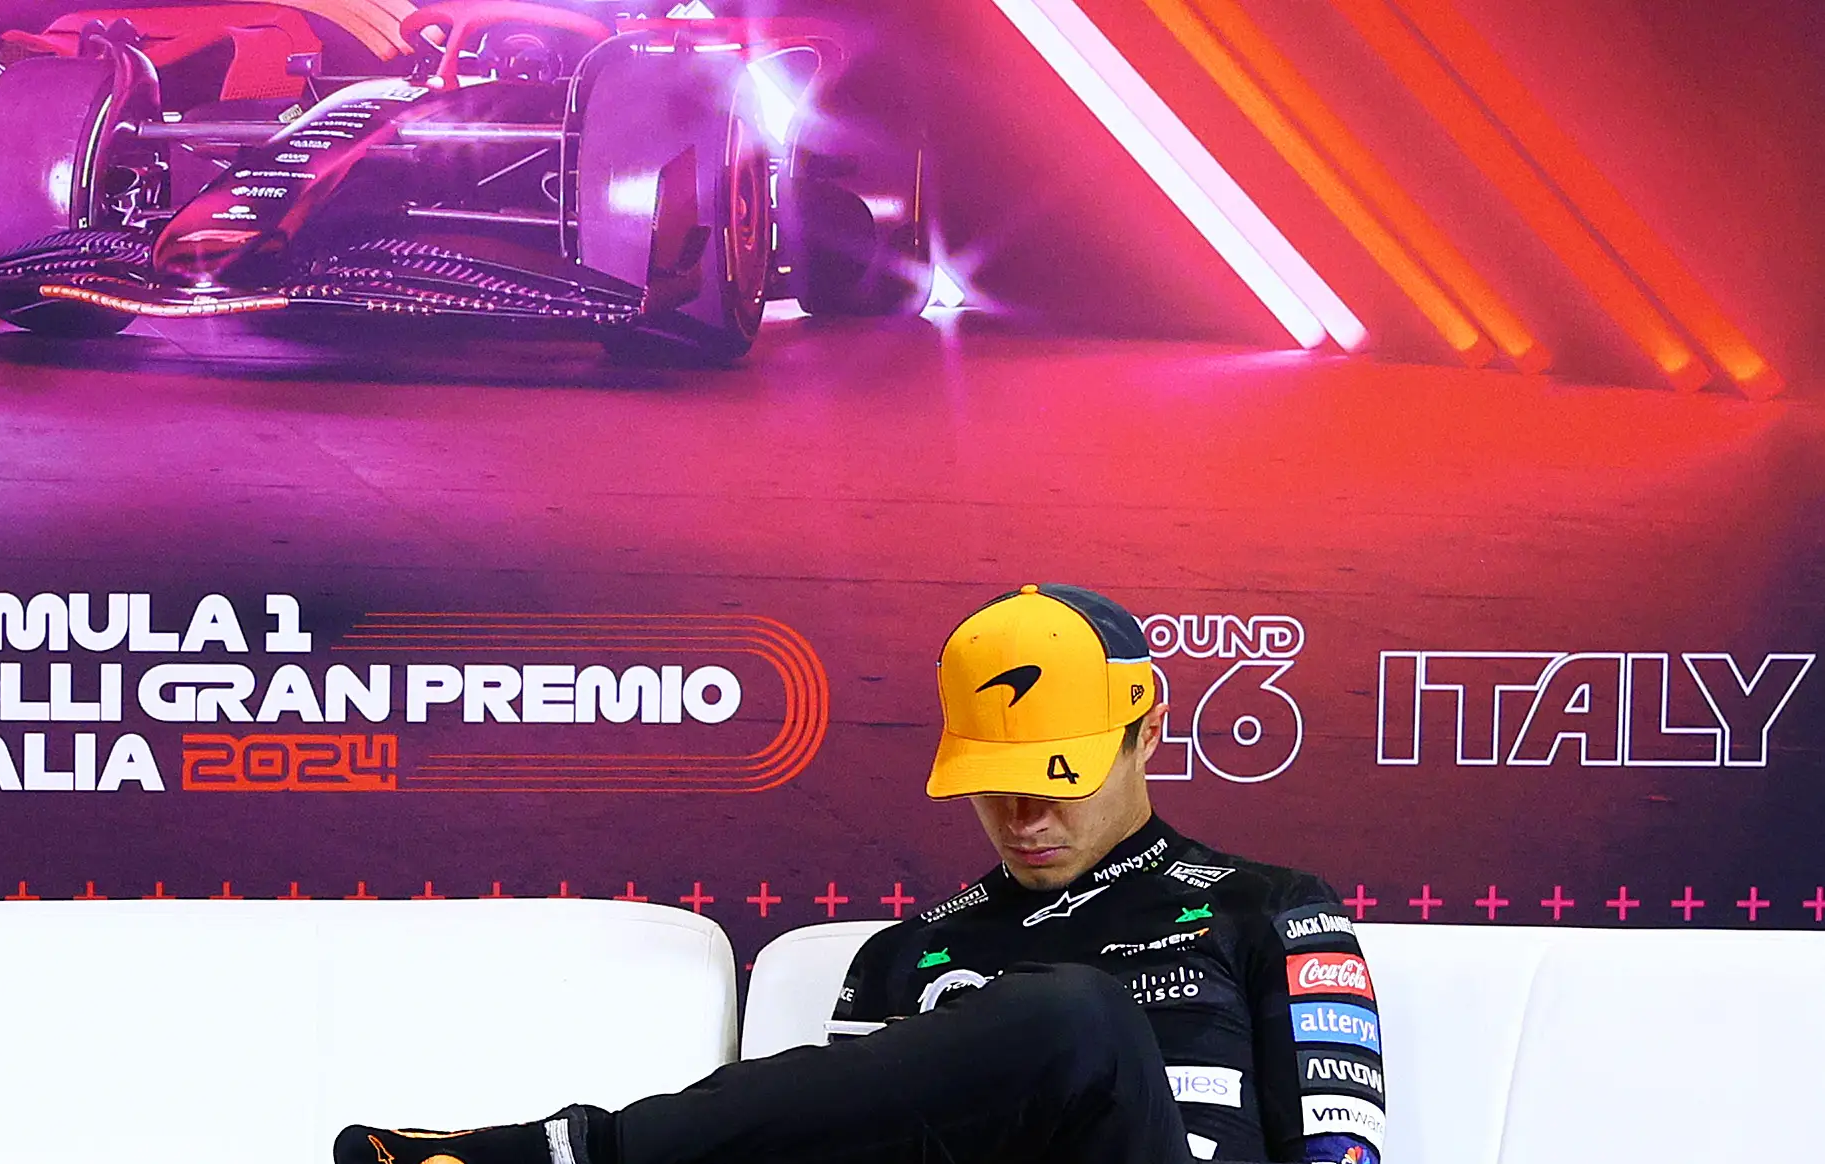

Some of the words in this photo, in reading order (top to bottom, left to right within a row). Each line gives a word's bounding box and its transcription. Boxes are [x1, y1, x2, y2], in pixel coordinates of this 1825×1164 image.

[265, 594, 312, 652] 1
[1131, 614, 1305, 659] OUND
[137, 663, 390, 723] GRAN
[406, 665, 742, 724] PREMIO
[1376, 650, 1817, 768] ITALY
[182, 734, 398, 792] 2024
[1046, 754, 1079, 784] 4
[1093, 838, 1169, 883] MONSTER
[1286, 918, 1323, 939] JACK
[1300, 1007, 1378, 1043] alteryx
